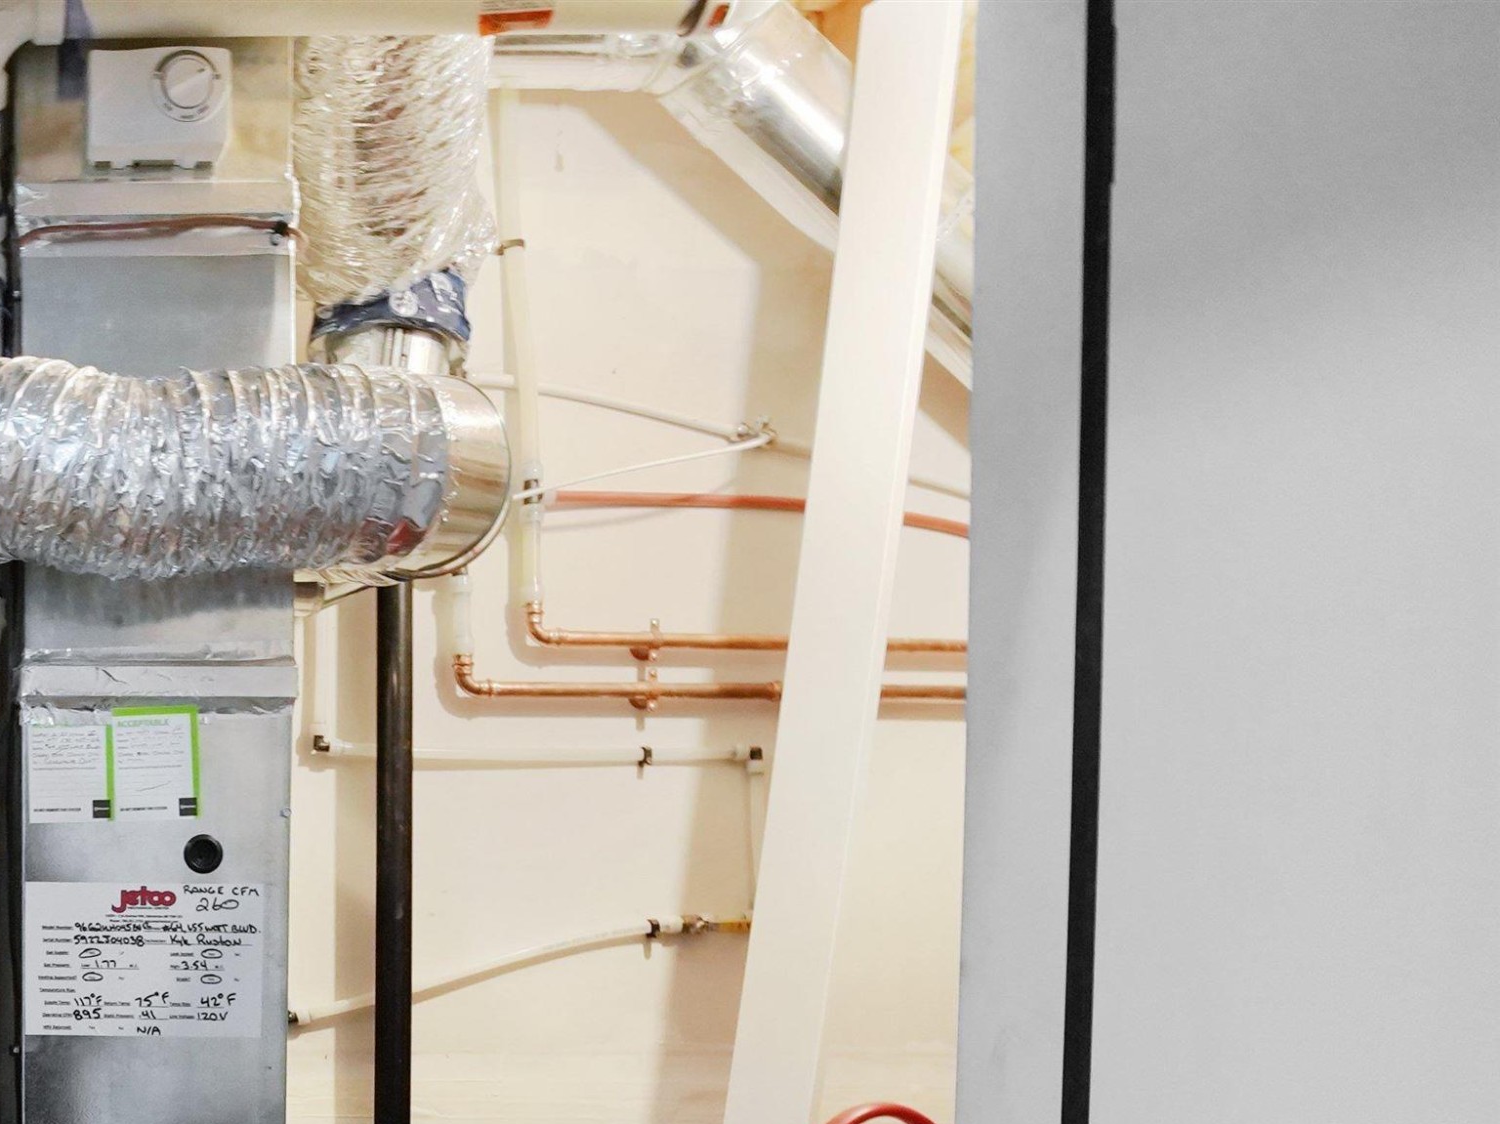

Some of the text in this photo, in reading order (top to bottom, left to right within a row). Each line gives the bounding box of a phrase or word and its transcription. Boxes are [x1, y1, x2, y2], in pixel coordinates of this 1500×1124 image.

[182, 884, 260, 897] RANGE CFM
[195, 897, 240, 913] 260
[181, 960, 209, 971] 3.54
[72, 1007, 103, 1021] 895
[136, 1025, 162, 1036] N/A
